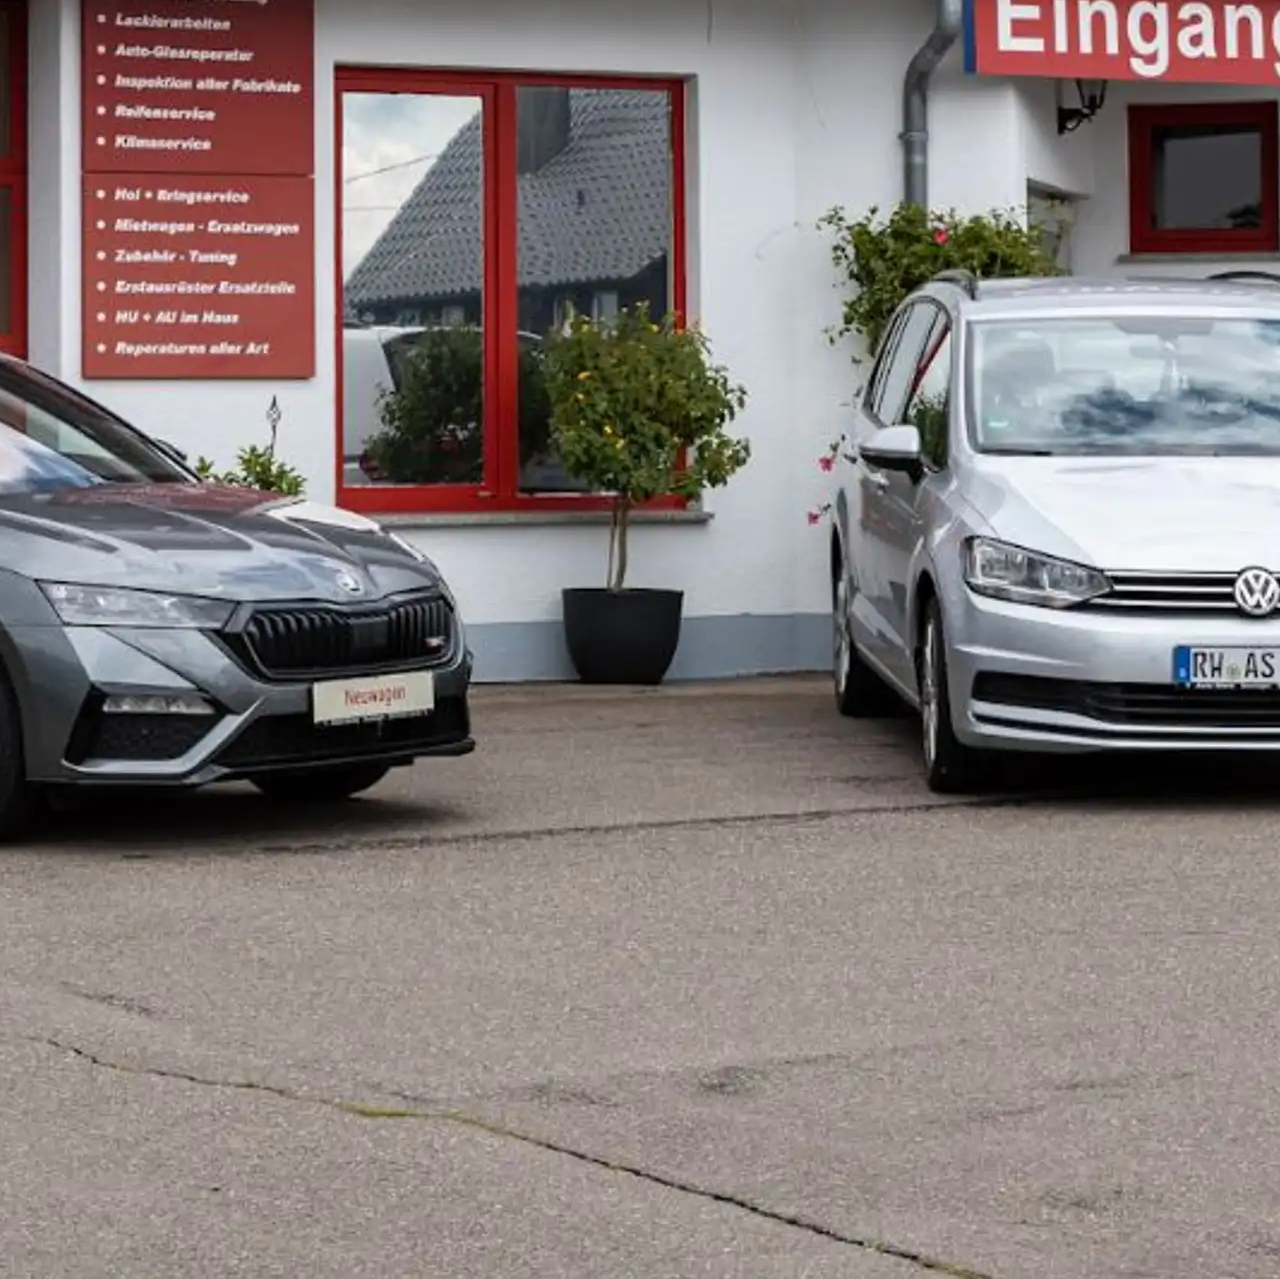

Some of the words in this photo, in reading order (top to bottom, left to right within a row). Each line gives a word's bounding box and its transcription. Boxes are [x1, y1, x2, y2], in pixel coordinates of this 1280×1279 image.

[114, 75, 193, 91] Inspektion
[195, 79, 230, 91] aller
[231, 79, 302, 94] Fabrikate
[114, 105, 217, 121] Reifenservice
[114, 135, 212, 151] Klimaservice
[156, 190, 251, 205] Bringservice
[114, 219, 195, 235] Mietwagen
[207, 220, 300, 237] Ersatzwagen
[189, 250, 238, 267] Tuning
[179, 312, 200, 324] im
[202, 312, 240, 324] Haus
[209, 342, 243, 355] aller
[245, 342, 271, 355] Art
[1245, 652, 1276, 678] AS
[344, 686, 407, 707] Neuwagen
